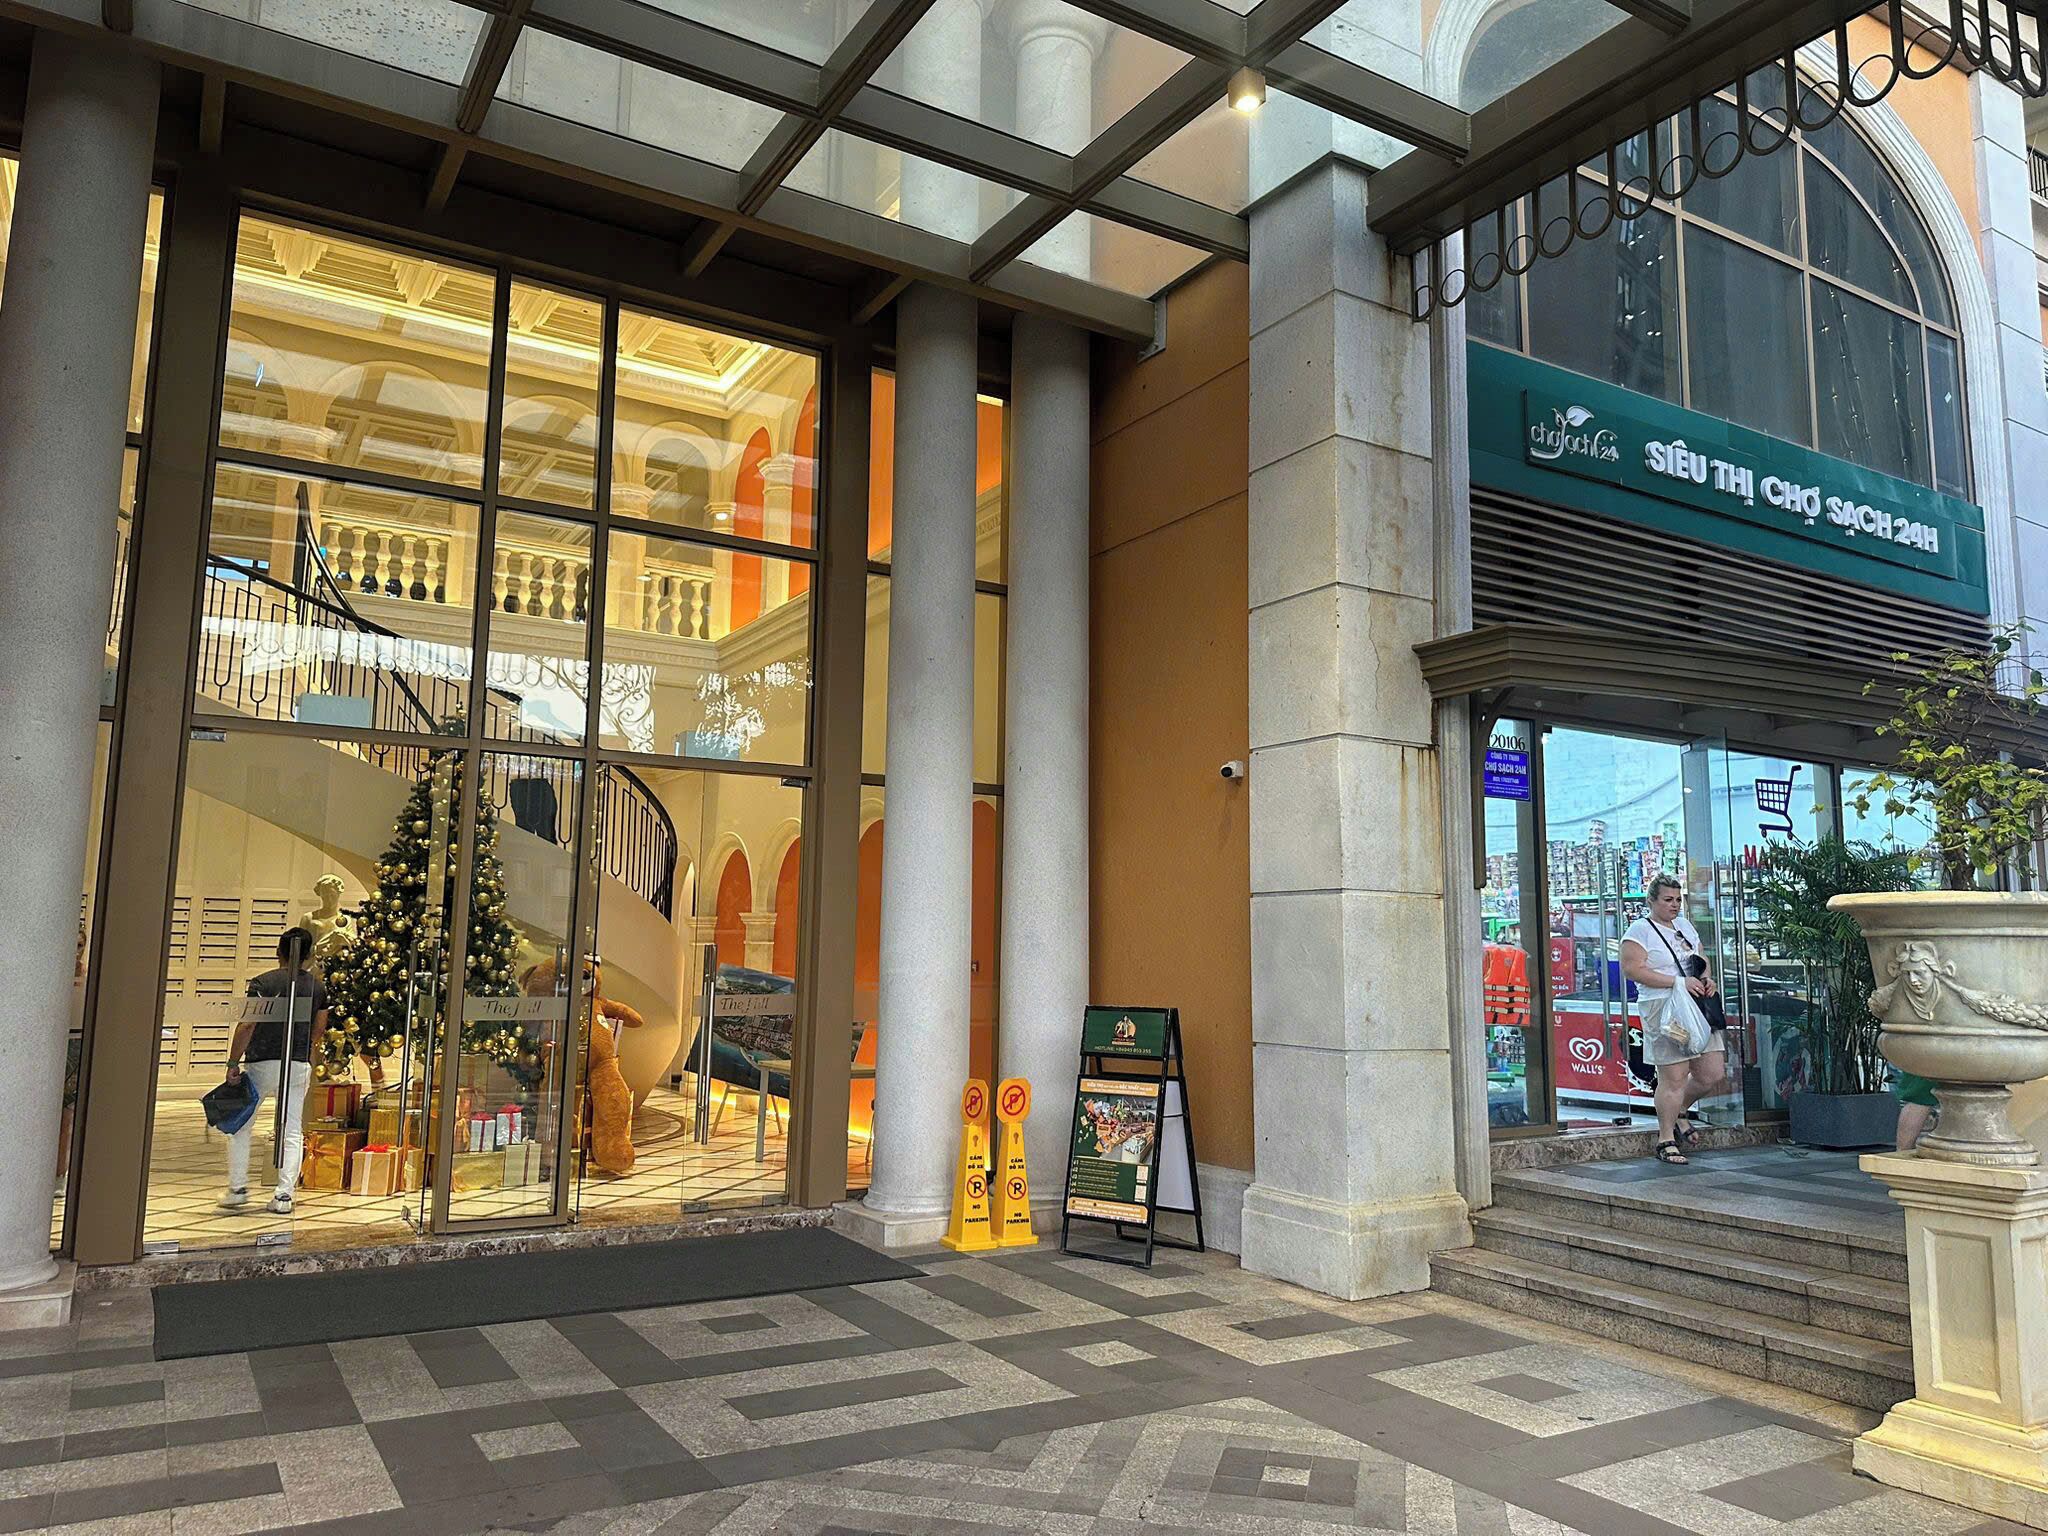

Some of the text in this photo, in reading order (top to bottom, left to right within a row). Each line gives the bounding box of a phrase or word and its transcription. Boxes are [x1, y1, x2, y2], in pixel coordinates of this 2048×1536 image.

[1645, 439, 1939, 554] SIÊU THỊ CHỢ SẠCH 24H
[1498, 762, 1514, 775] SẠCH
[483, 1000, 511, 1016] The
[721, 998, 744, 1011] The
[1571, 1062, 1603, 1075] WALL'S
